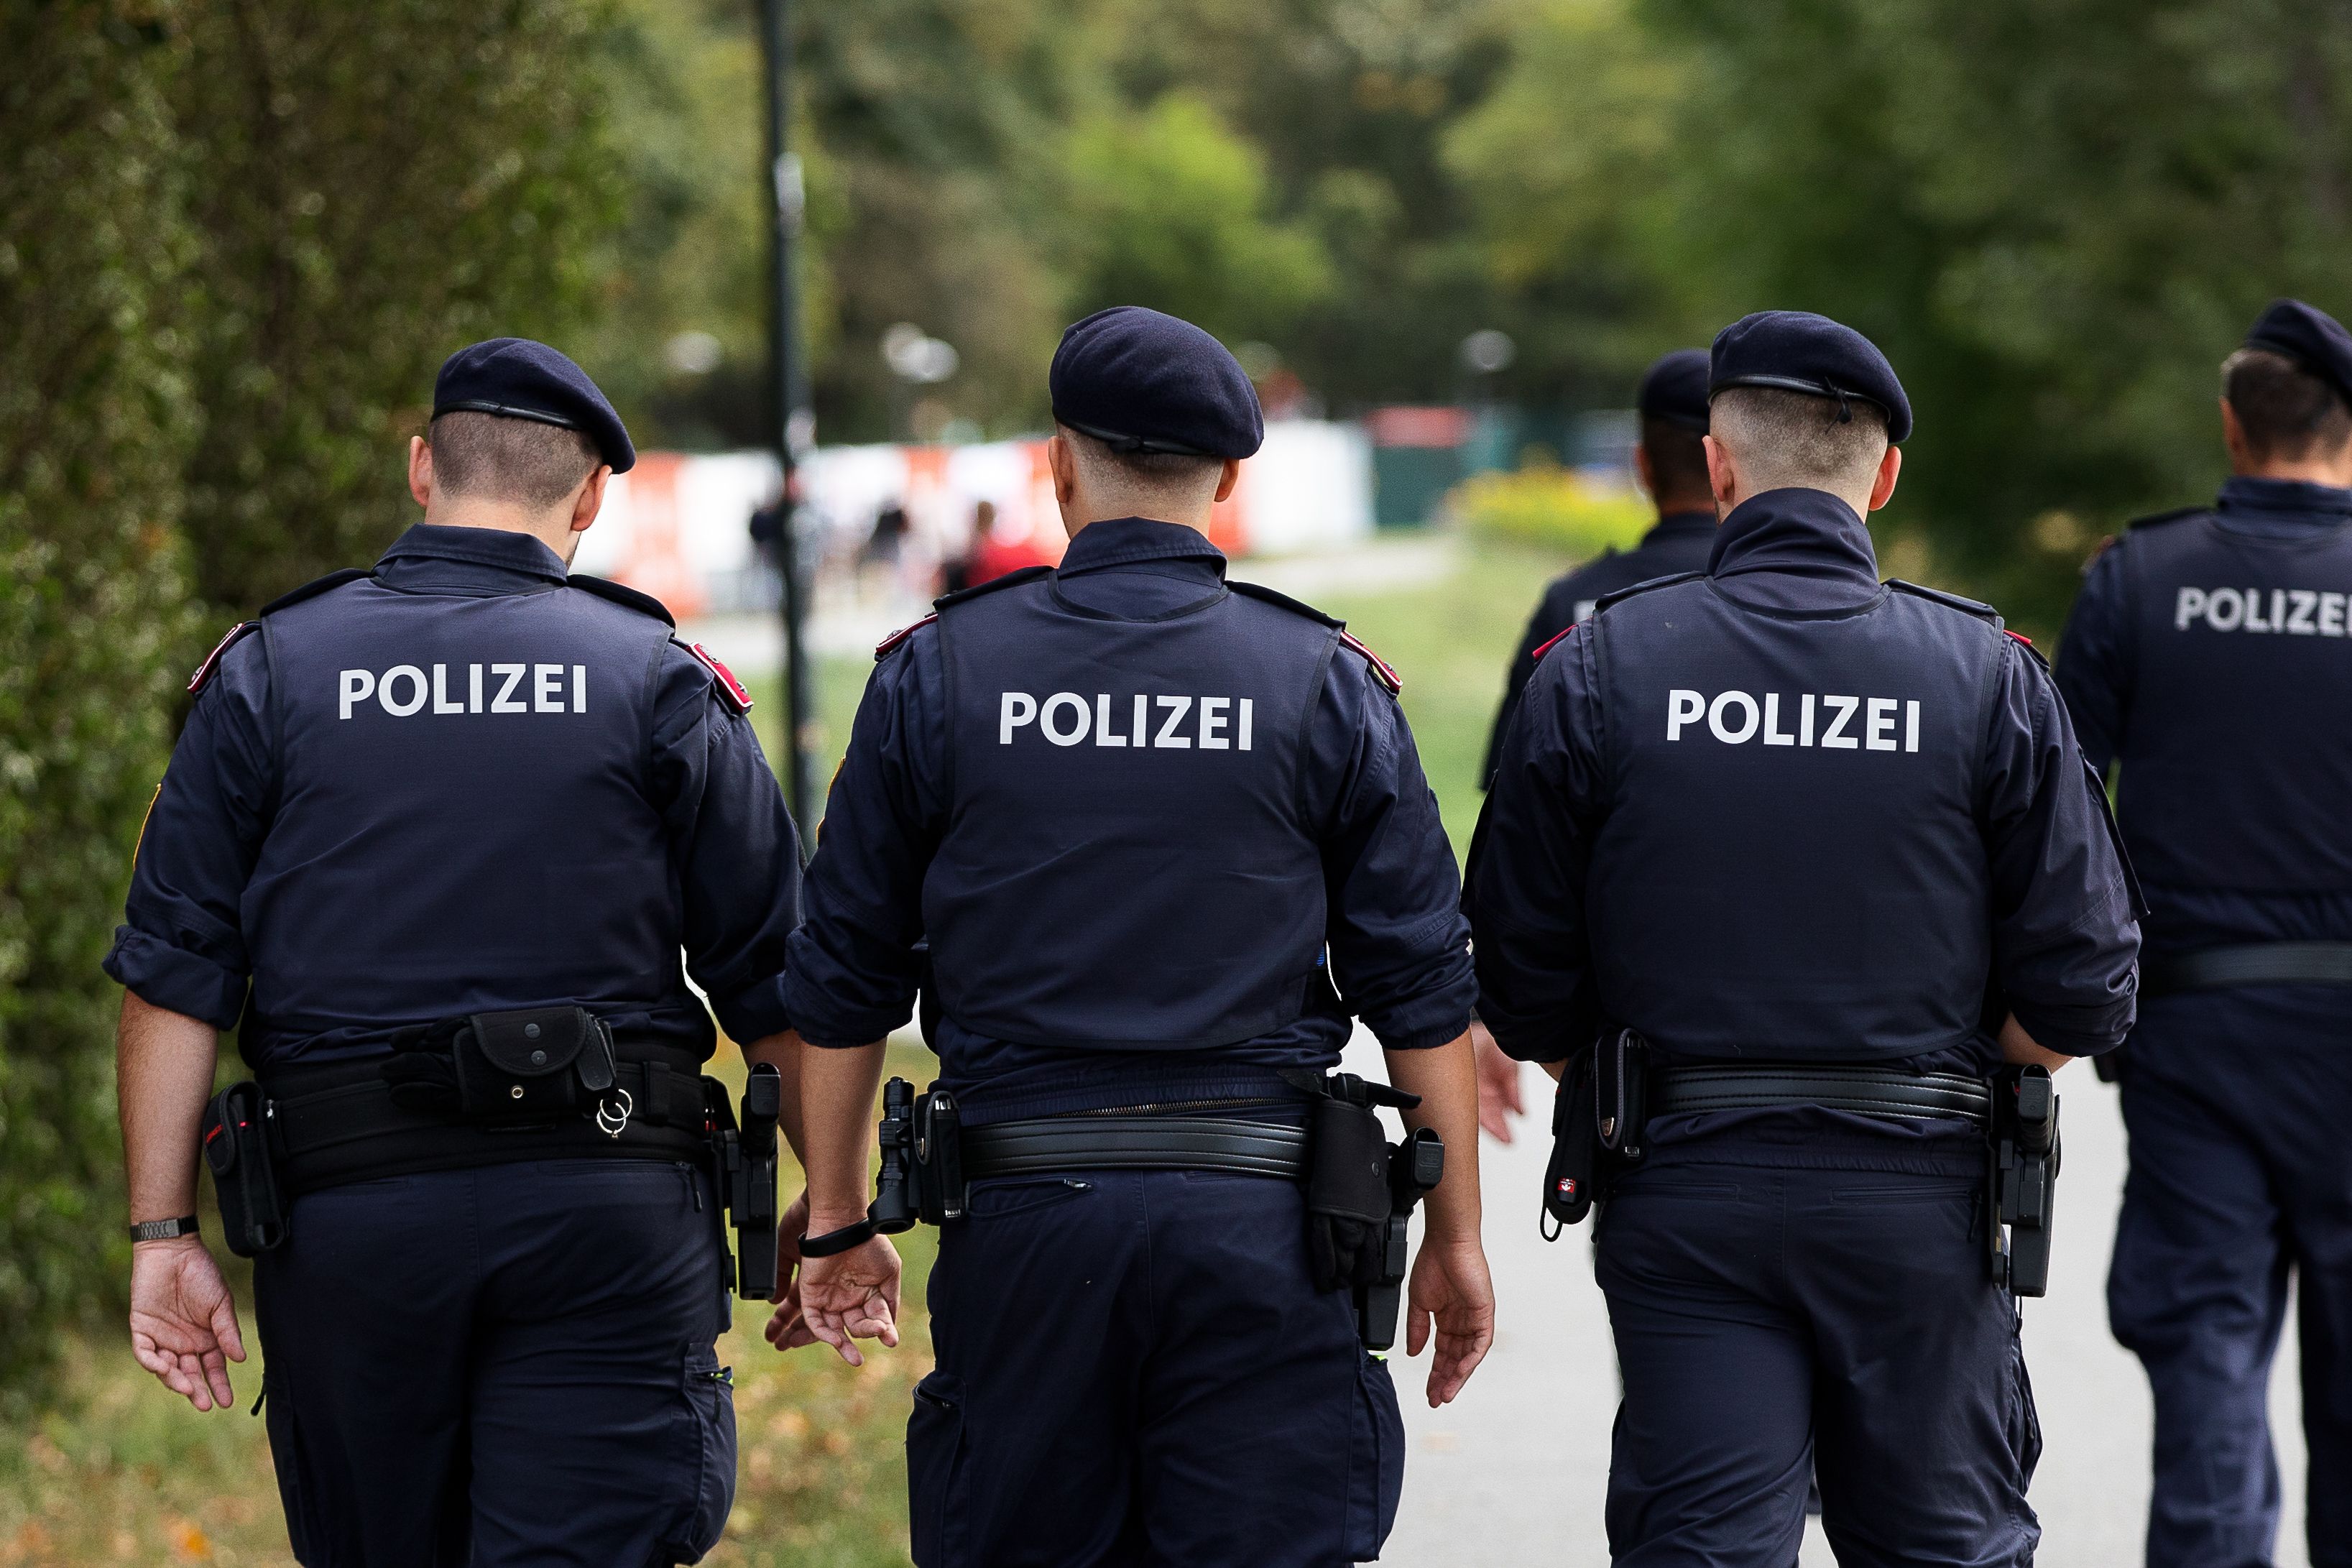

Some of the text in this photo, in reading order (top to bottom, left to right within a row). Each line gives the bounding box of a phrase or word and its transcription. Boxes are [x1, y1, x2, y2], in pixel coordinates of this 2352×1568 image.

[339, 663, 586, 720] POLIZEI
[1000, 691, 1254, 752] POLIZEI
[1666, 688, 1921, 754] POLIZEI
